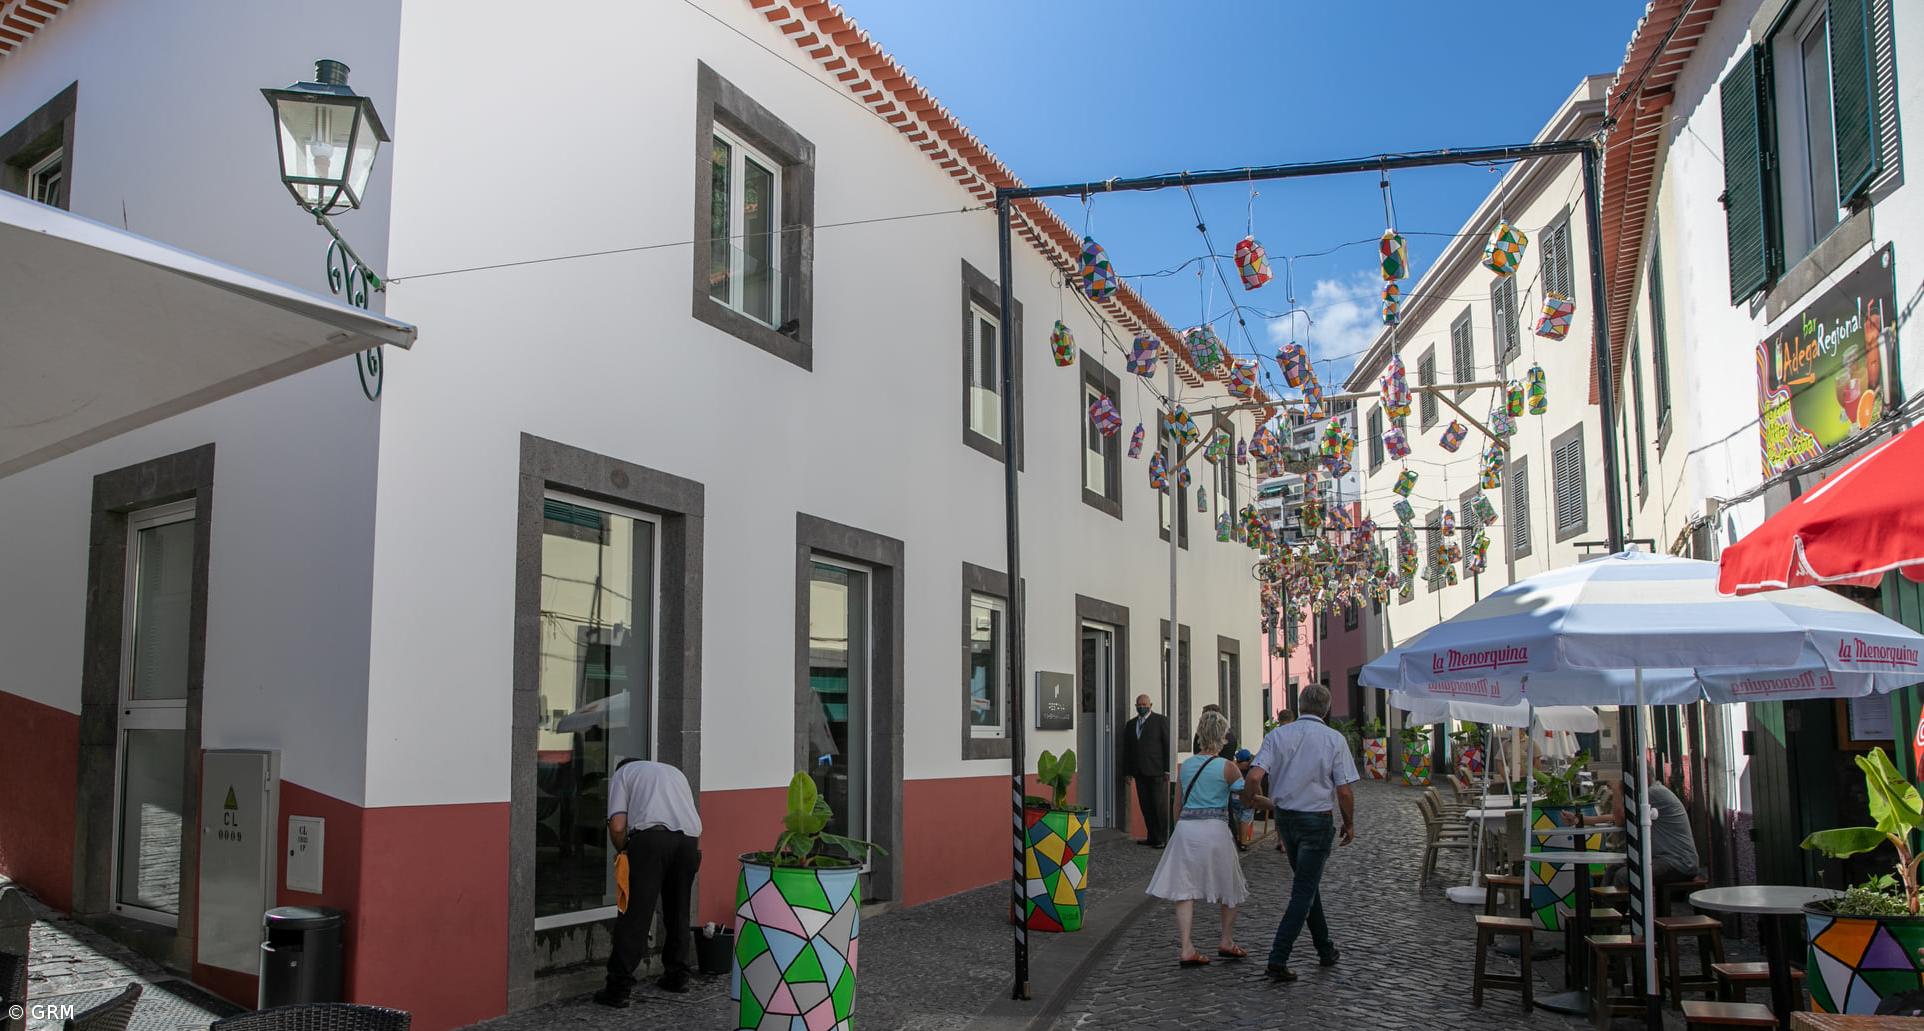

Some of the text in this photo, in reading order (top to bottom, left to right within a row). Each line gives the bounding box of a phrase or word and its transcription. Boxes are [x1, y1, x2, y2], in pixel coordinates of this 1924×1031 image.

[1803, 312, 1816, 338] bar
[1783, 296, 1862, 382] Adega Regional
[1432, 645, 1528, 671] la Menorquina
[1839, 637, 1919, 667] la Menorquina
[224, 811, 239, 827] CL
